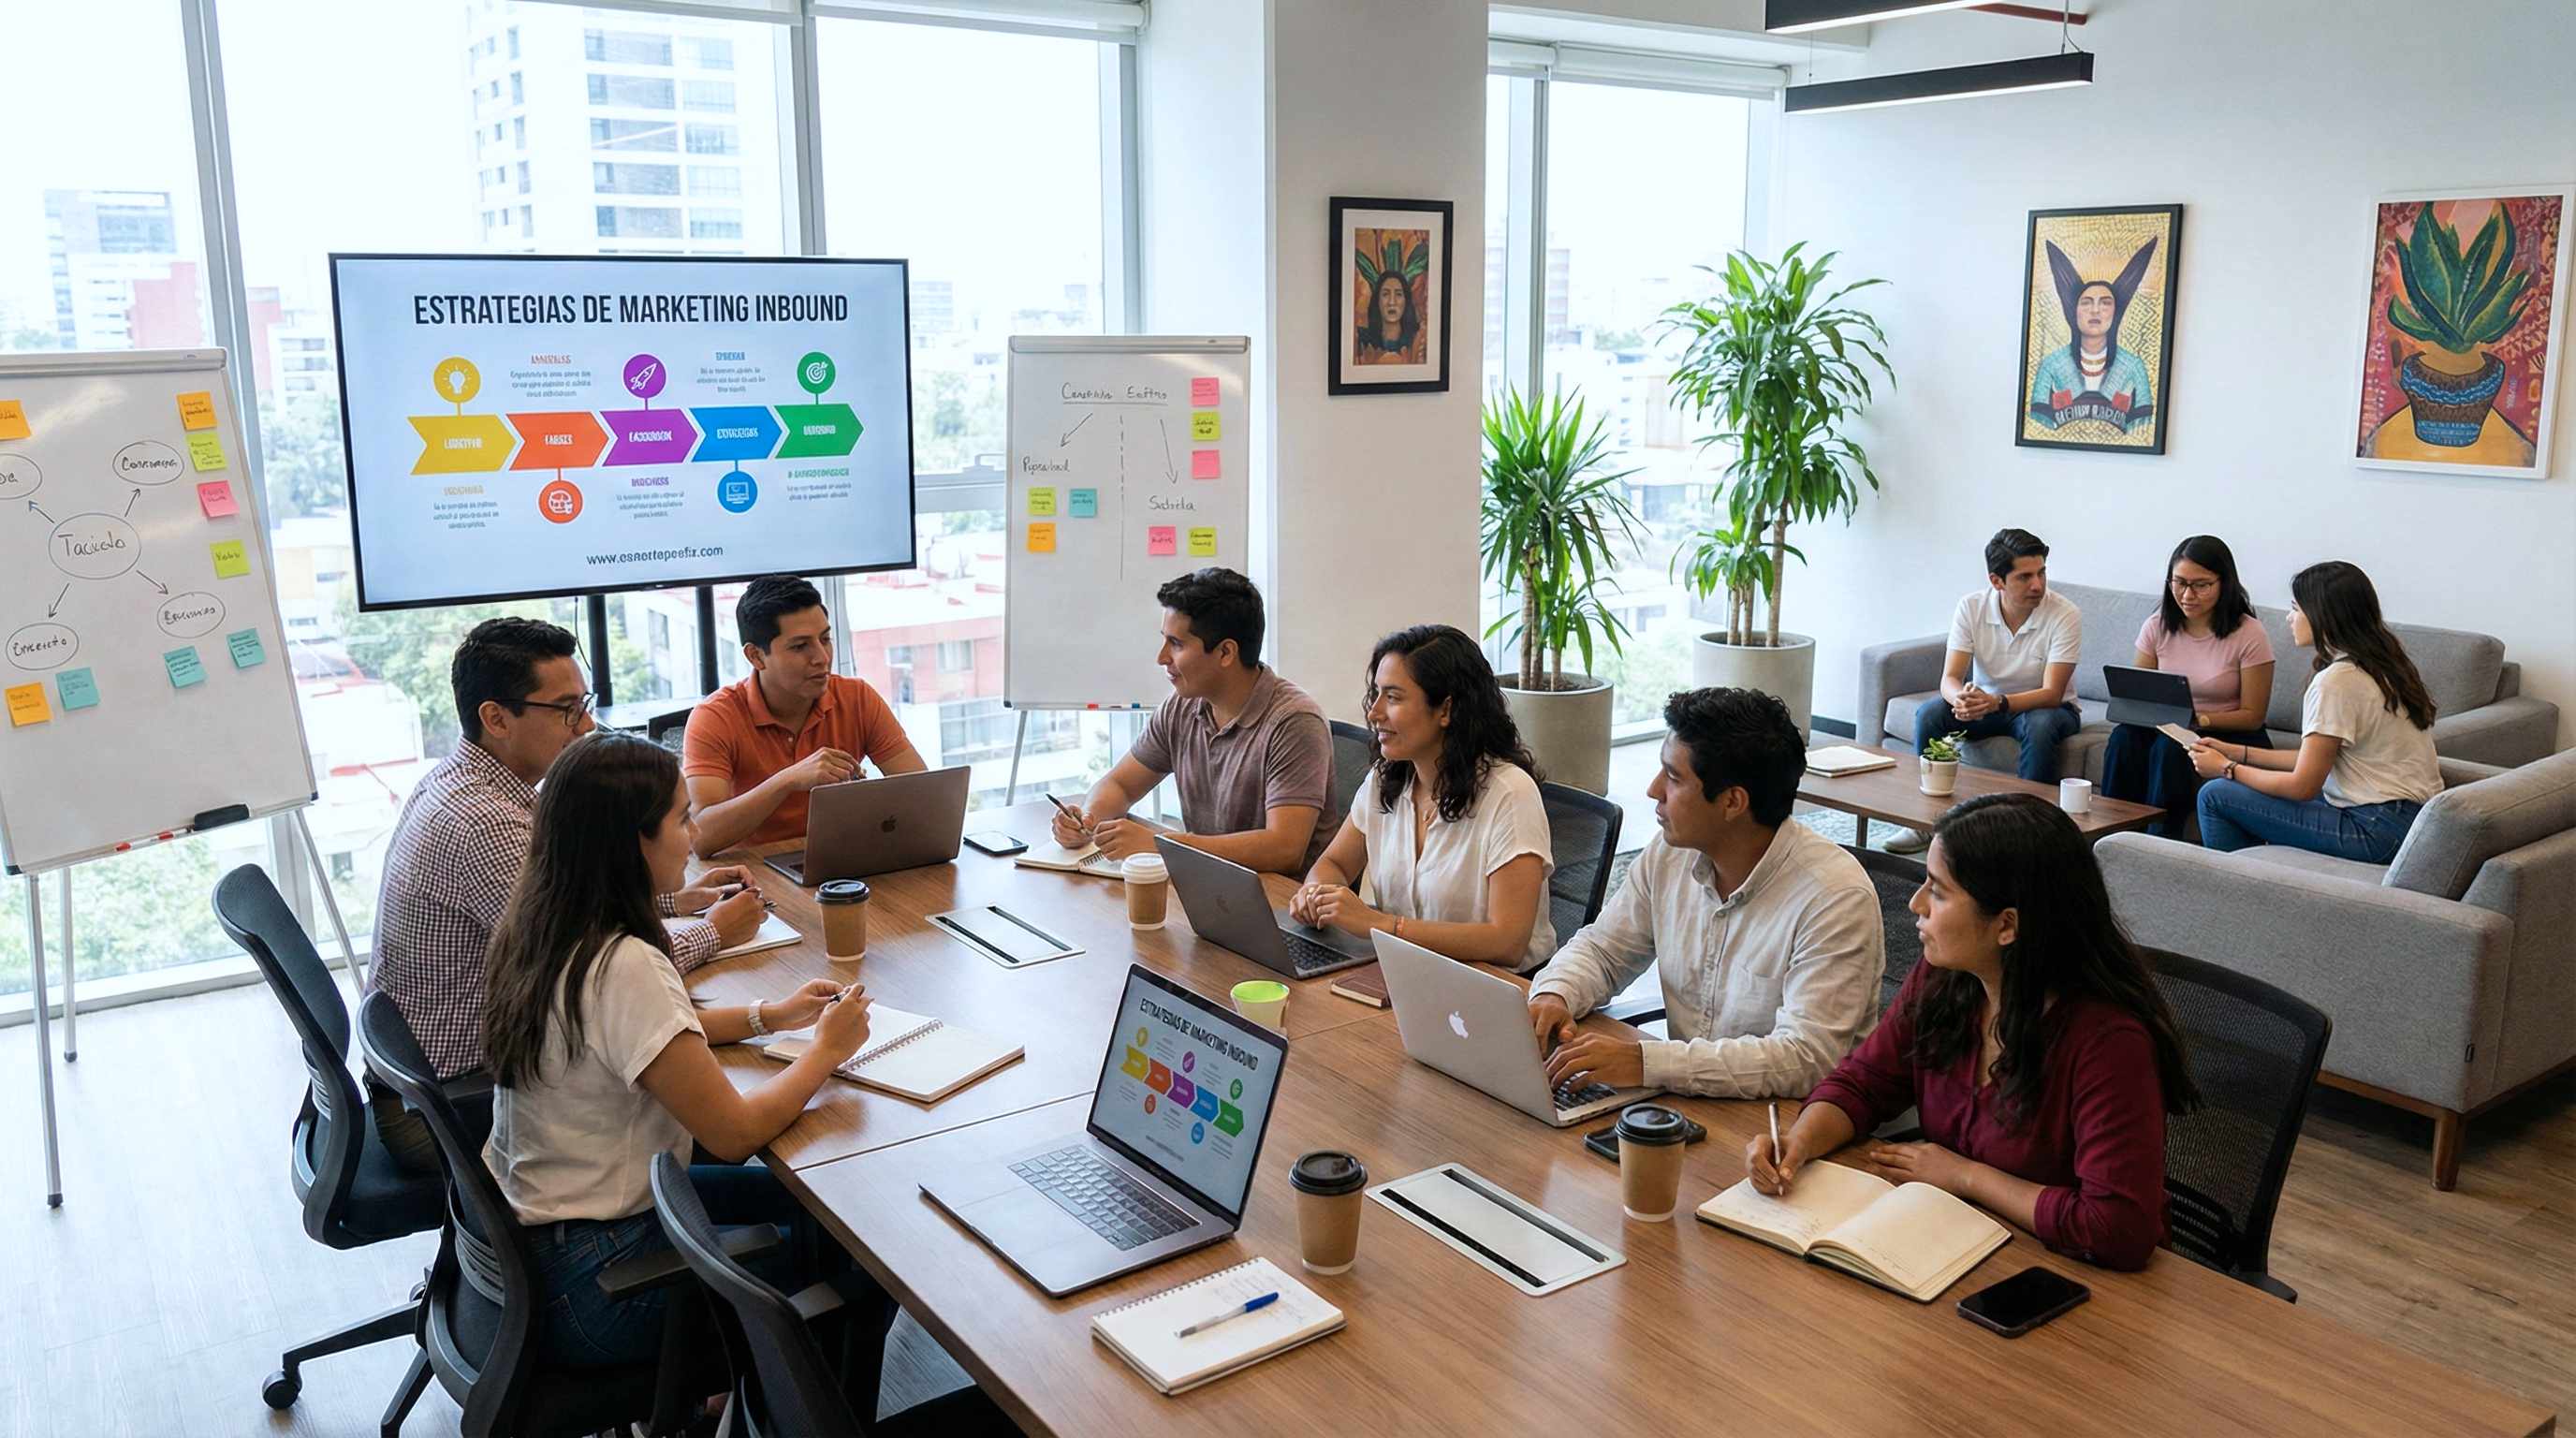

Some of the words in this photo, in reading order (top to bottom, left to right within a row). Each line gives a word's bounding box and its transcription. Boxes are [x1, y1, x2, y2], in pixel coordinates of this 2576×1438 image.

[414, 295, 577, 324] ESTRATEGIAS
[582, 295, 612, 323] DE
[619, 295, 749, 323] MARKETING
[755, 294, 848, 322] INBOUND
